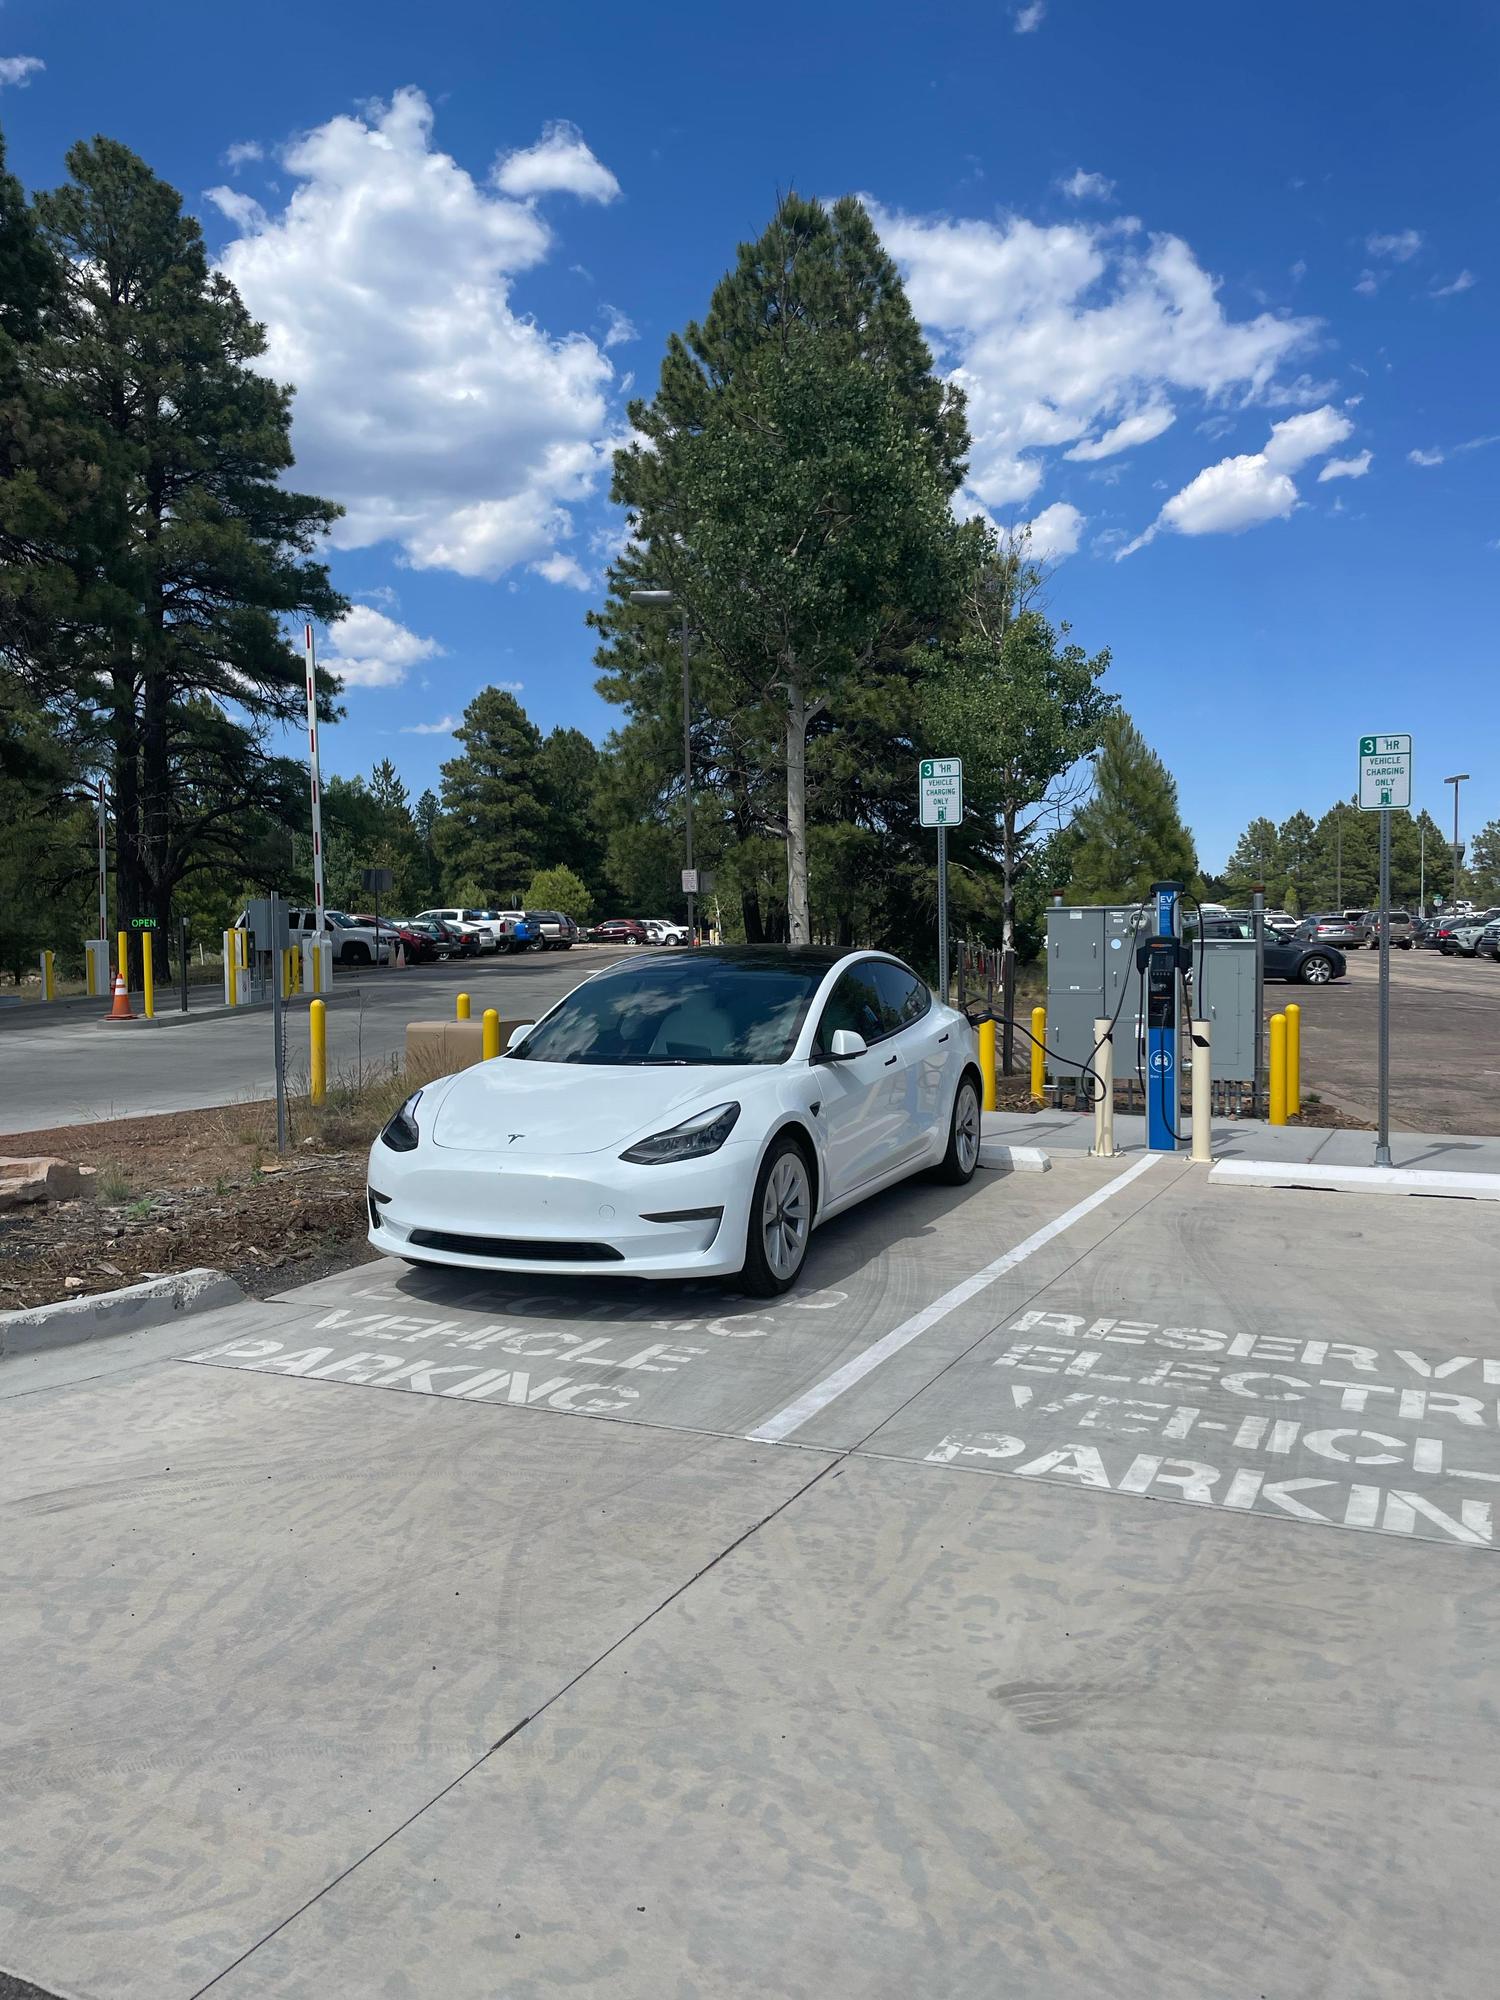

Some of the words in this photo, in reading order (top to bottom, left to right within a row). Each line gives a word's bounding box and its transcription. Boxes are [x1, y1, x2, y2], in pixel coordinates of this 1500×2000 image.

[1363, 740, 1374, 754] 3
[1385, 740, 1400, 751] HR
[1369, 756, 1401, 766] VEHICLE
[924, 763, 932, 776] 3
[940, 764, 952, 773] HR
[1366, 767, 1405, 776] CHARGING
[928, 778, 953, 786] VEHICLE
[1375, 778, 1395, 786] ONLY
[926, 788, 956, 796] CHARGING
[933, 798, 949, 806] ONLY
[1160, 895, 1173, 903] EV
[131, 919, 156, 928] OPEN
[312, 1309, 710, 1373] VEHICLE
[1008, 1310, 1500, 1385] RESERV
[171, 1338, 640, 1412] PARKING
[991, 1342, 1500, 1428] ELECTR
